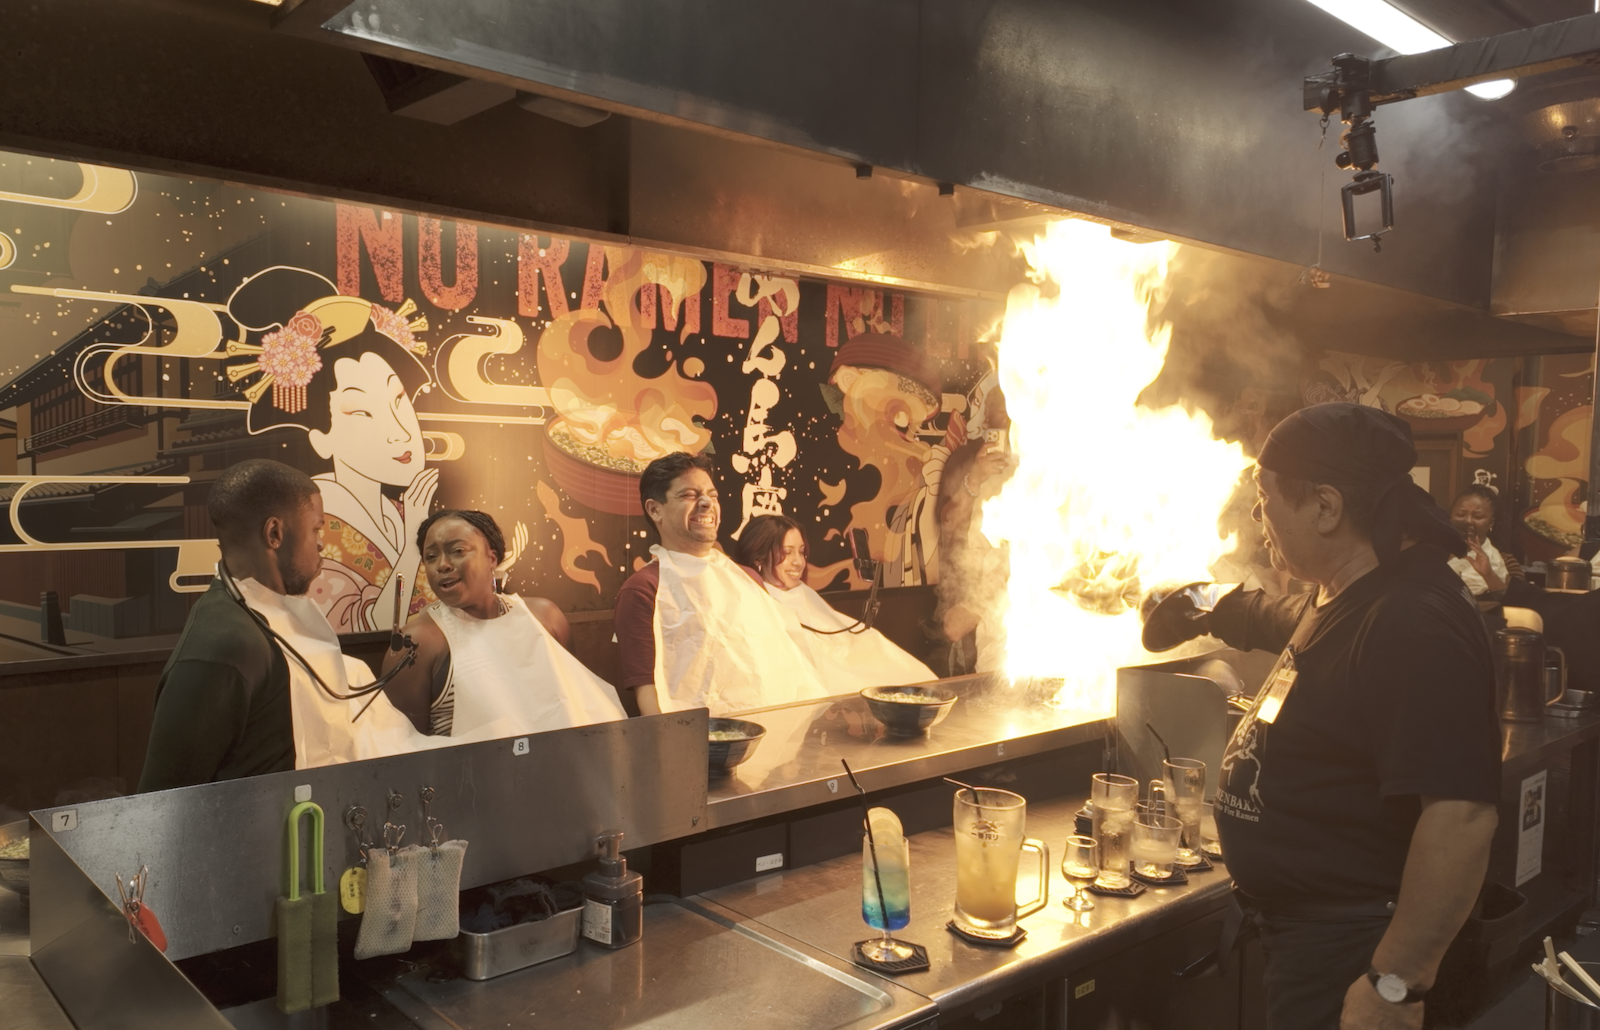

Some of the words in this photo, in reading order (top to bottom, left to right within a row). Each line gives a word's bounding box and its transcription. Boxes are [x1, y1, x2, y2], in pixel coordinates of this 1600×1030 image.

[518, 231, 799, 344] RAMEN
[518, 741, 525, 751] 8
[1223, 805, 1235, 817] Fire
[1235, 808, 1260, 822] Ramen
[61, 815, 69, 827] 7
